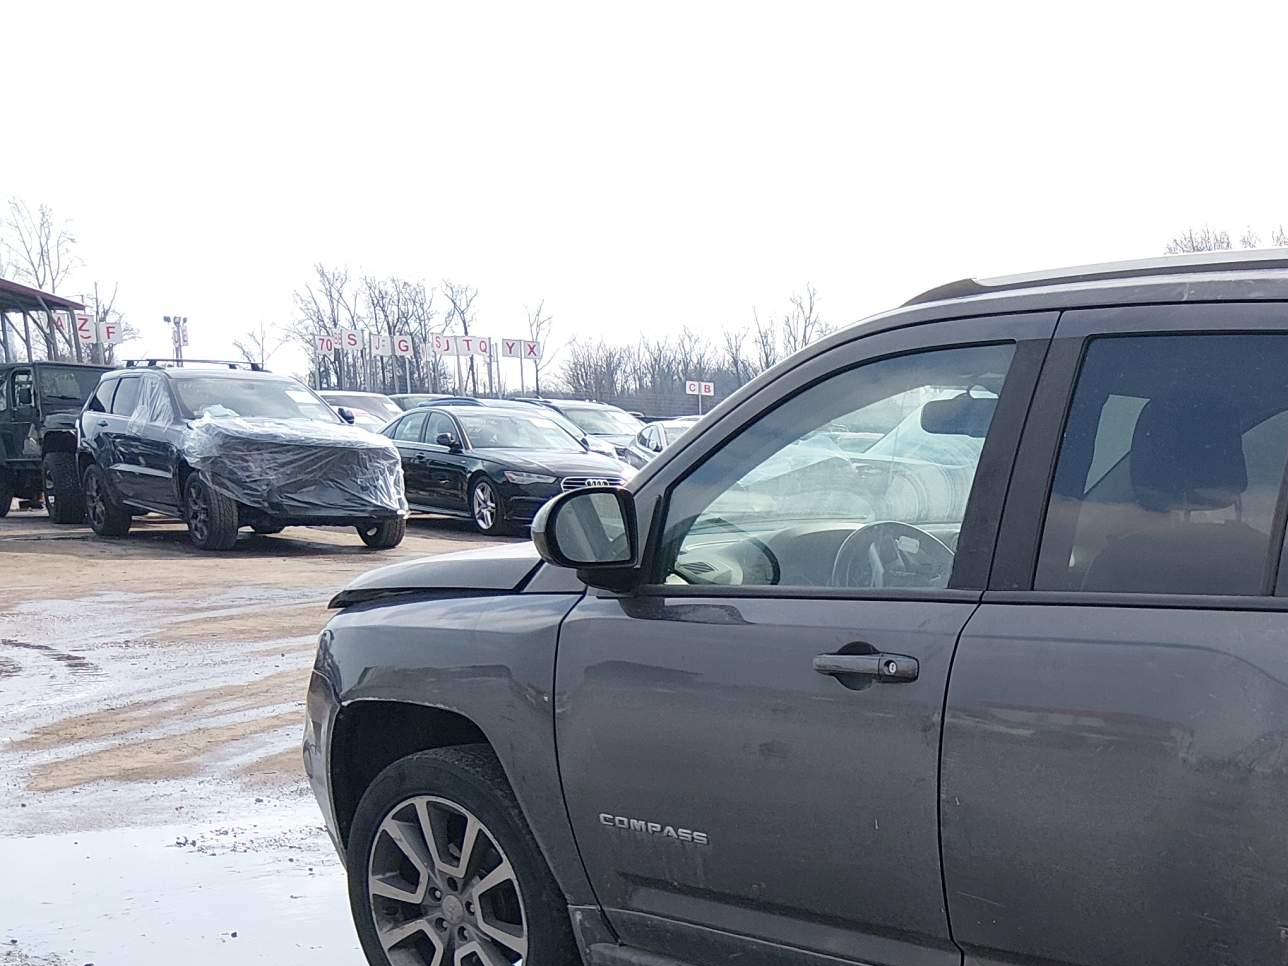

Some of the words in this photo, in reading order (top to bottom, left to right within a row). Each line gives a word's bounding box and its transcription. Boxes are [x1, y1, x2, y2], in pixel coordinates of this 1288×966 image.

[106, 325, 116, 340] F
[318, 338, 333, 352] 70
[347, 333, 358, 346] S
[398, 339, 409, 352] G
[443, 339, 450, 351] J
[463, 339, 472, 351] T
[506, 342, 515, 354] Y
[527, 344, 537, 357] X
[599, 812, 709, 845] COMPASS
